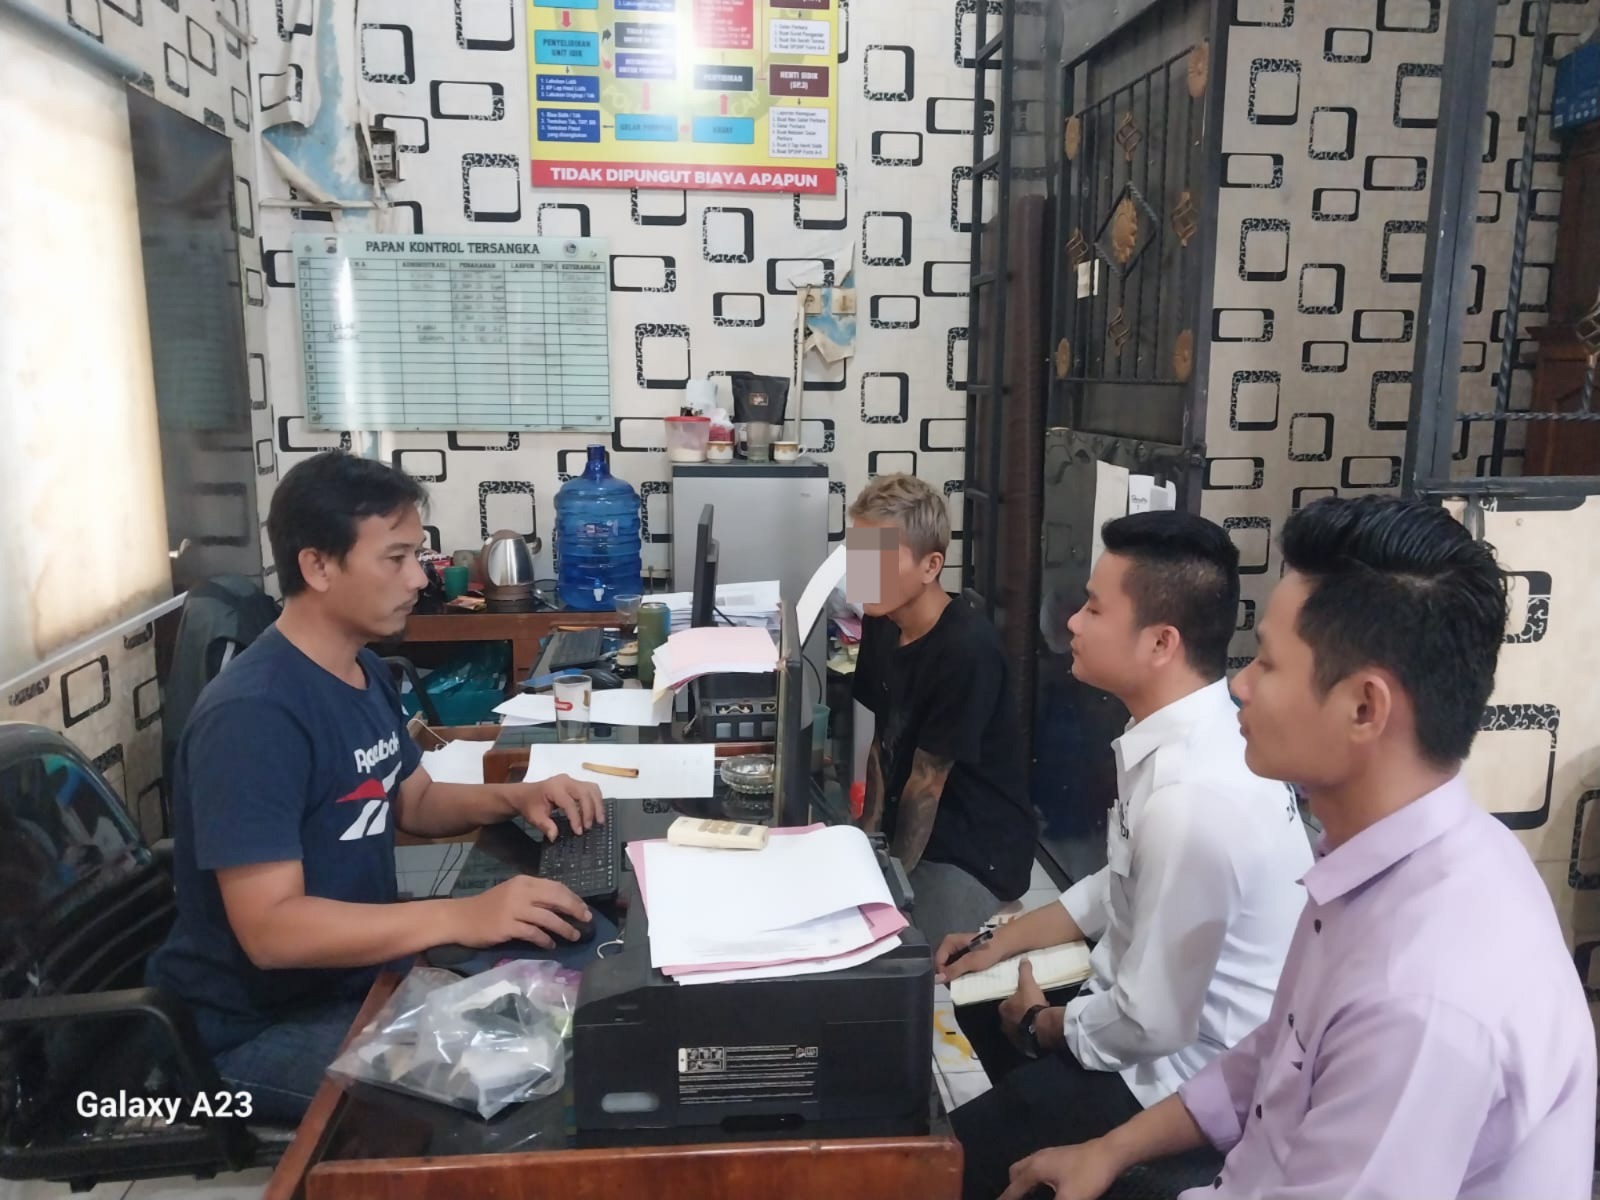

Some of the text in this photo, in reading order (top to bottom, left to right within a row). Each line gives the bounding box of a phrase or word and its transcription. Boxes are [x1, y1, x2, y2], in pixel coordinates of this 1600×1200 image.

[543, 38, 591, 48] PENYELIDIKAN
[550, 167, 818, 188] TIDAK DIPUNGUT BIAYA APAPUN
[366, 240, 541, 255] PAPAN KONTROL TERSANGKA
